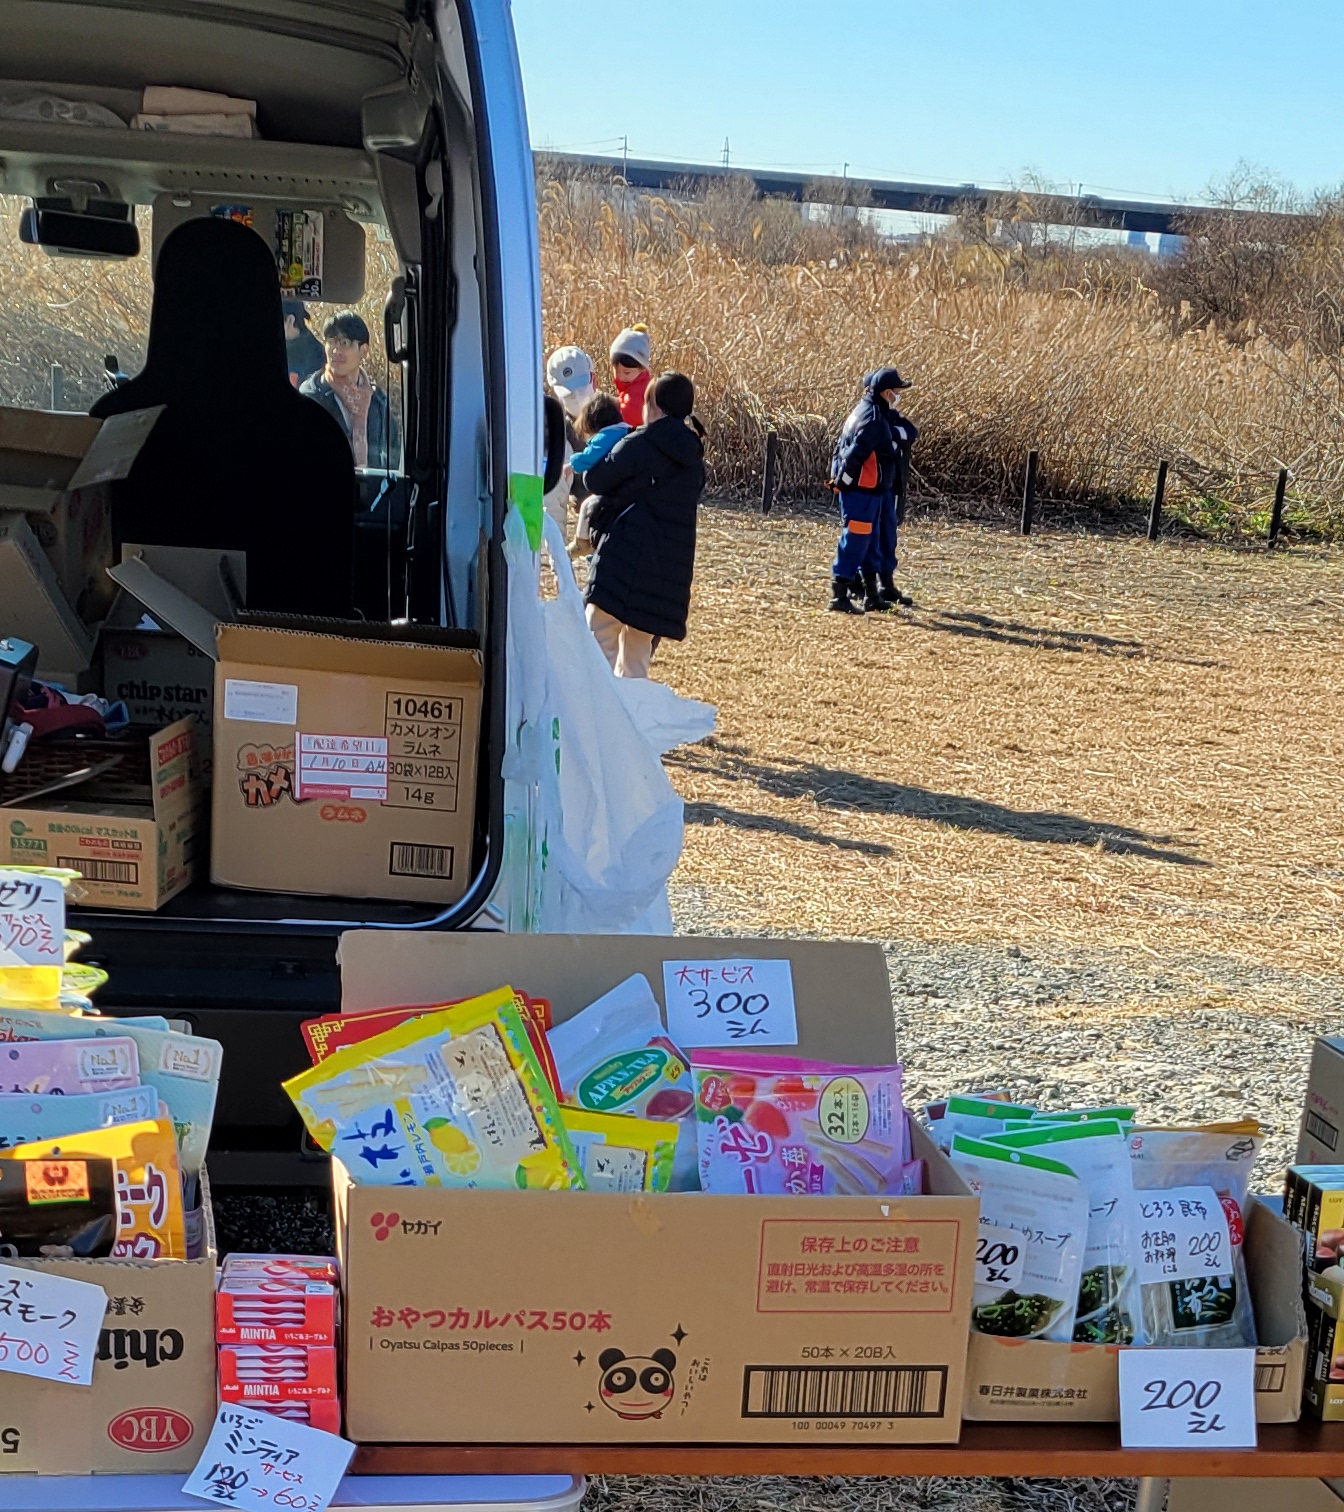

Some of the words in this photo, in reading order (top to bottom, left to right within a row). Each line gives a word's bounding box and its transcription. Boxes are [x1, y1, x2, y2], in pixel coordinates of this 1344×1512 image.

[393, 698, 454, 720] 10461
[389, 721, 457, 741] カメレオン
[403, 740, 443, 758] ラムネ
[404, 786, 436, 805] 14g
[322, 807, 368, 823] ラムネ
[674, 964, 755, 987] 大サービス
[687, 987, 771, 1019] 300
[400, 1218, 443, 1236] ヤガイ
[800, 1235, 921, 1254] 保存上のご注意
[1187, 1231, 1222, 1257] 200
[767, 1262, 946, 1278] 直射日光および高温多湿の所を
[765, 1279, 949, 1295] 避け、常温で保存してください。
[369, 1305, 613, 1333] おやつカルパス50本
[239, 1327, 277, 1341] MINTIA
[379, 1338, 421, 1353] Oyatsu
[422, 1339, 460, 1353] Calpas
[462, 1339, 514, 1354] 50pieces
[243, 1383, 281, 1397] MINTIA
[978, 1384, 1089, 1400] 春日井製菓株式会社
[1139, 1379, 1223, 1412] 200
[120, 1417, 182, 1444] YBC
[1186, 1410, 1227, 1434] えん
